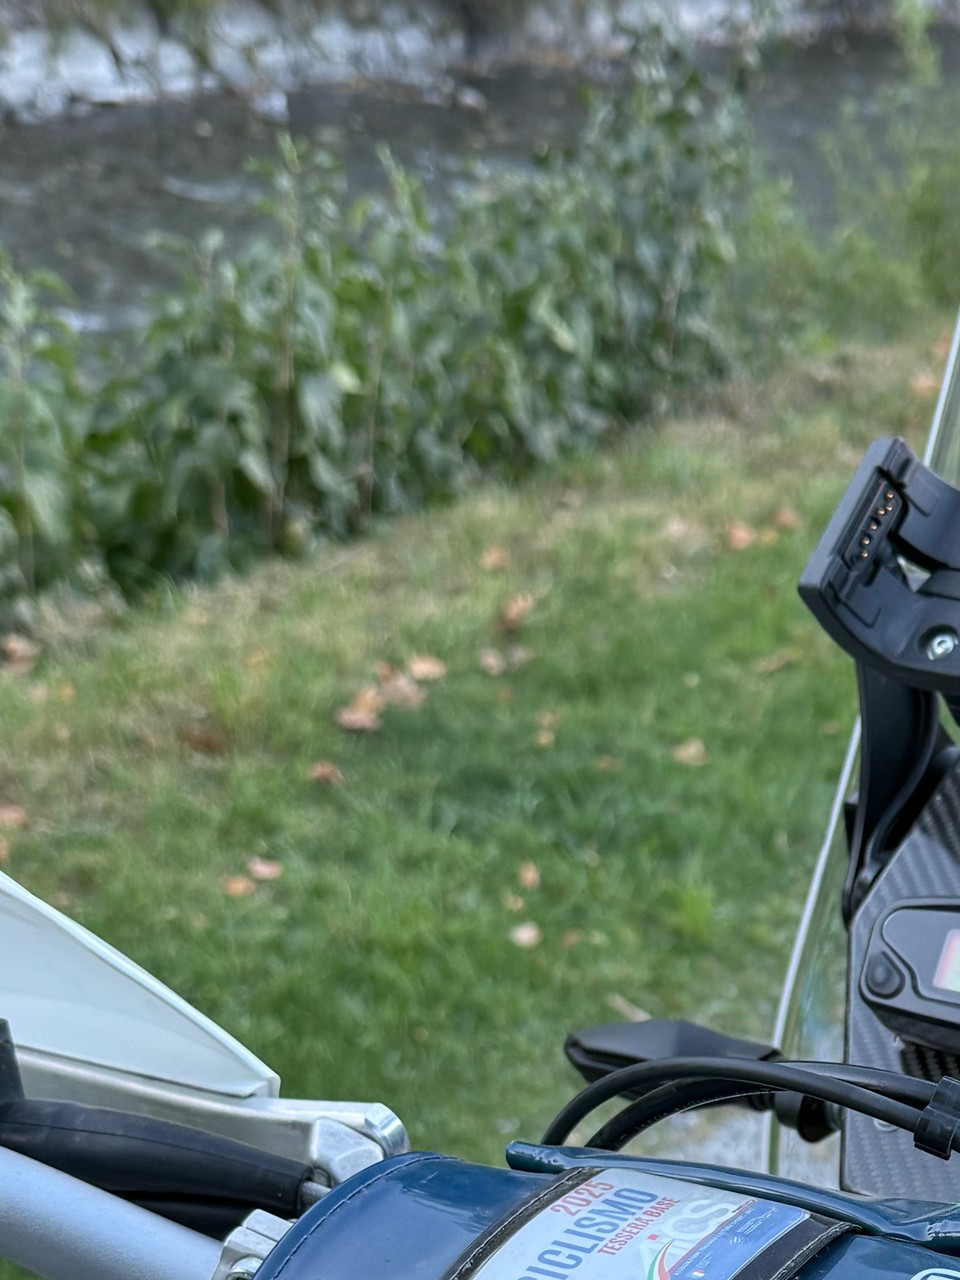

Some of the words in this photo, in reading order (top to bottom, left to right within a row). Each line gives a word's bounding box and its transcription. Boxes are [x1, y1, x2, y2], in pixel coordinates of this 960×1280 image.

[551, 1179, 616, 1217] 2025
[597, 1216, 653, 1256] TESSERA
[642, 1196, 681, 1219] BASE
